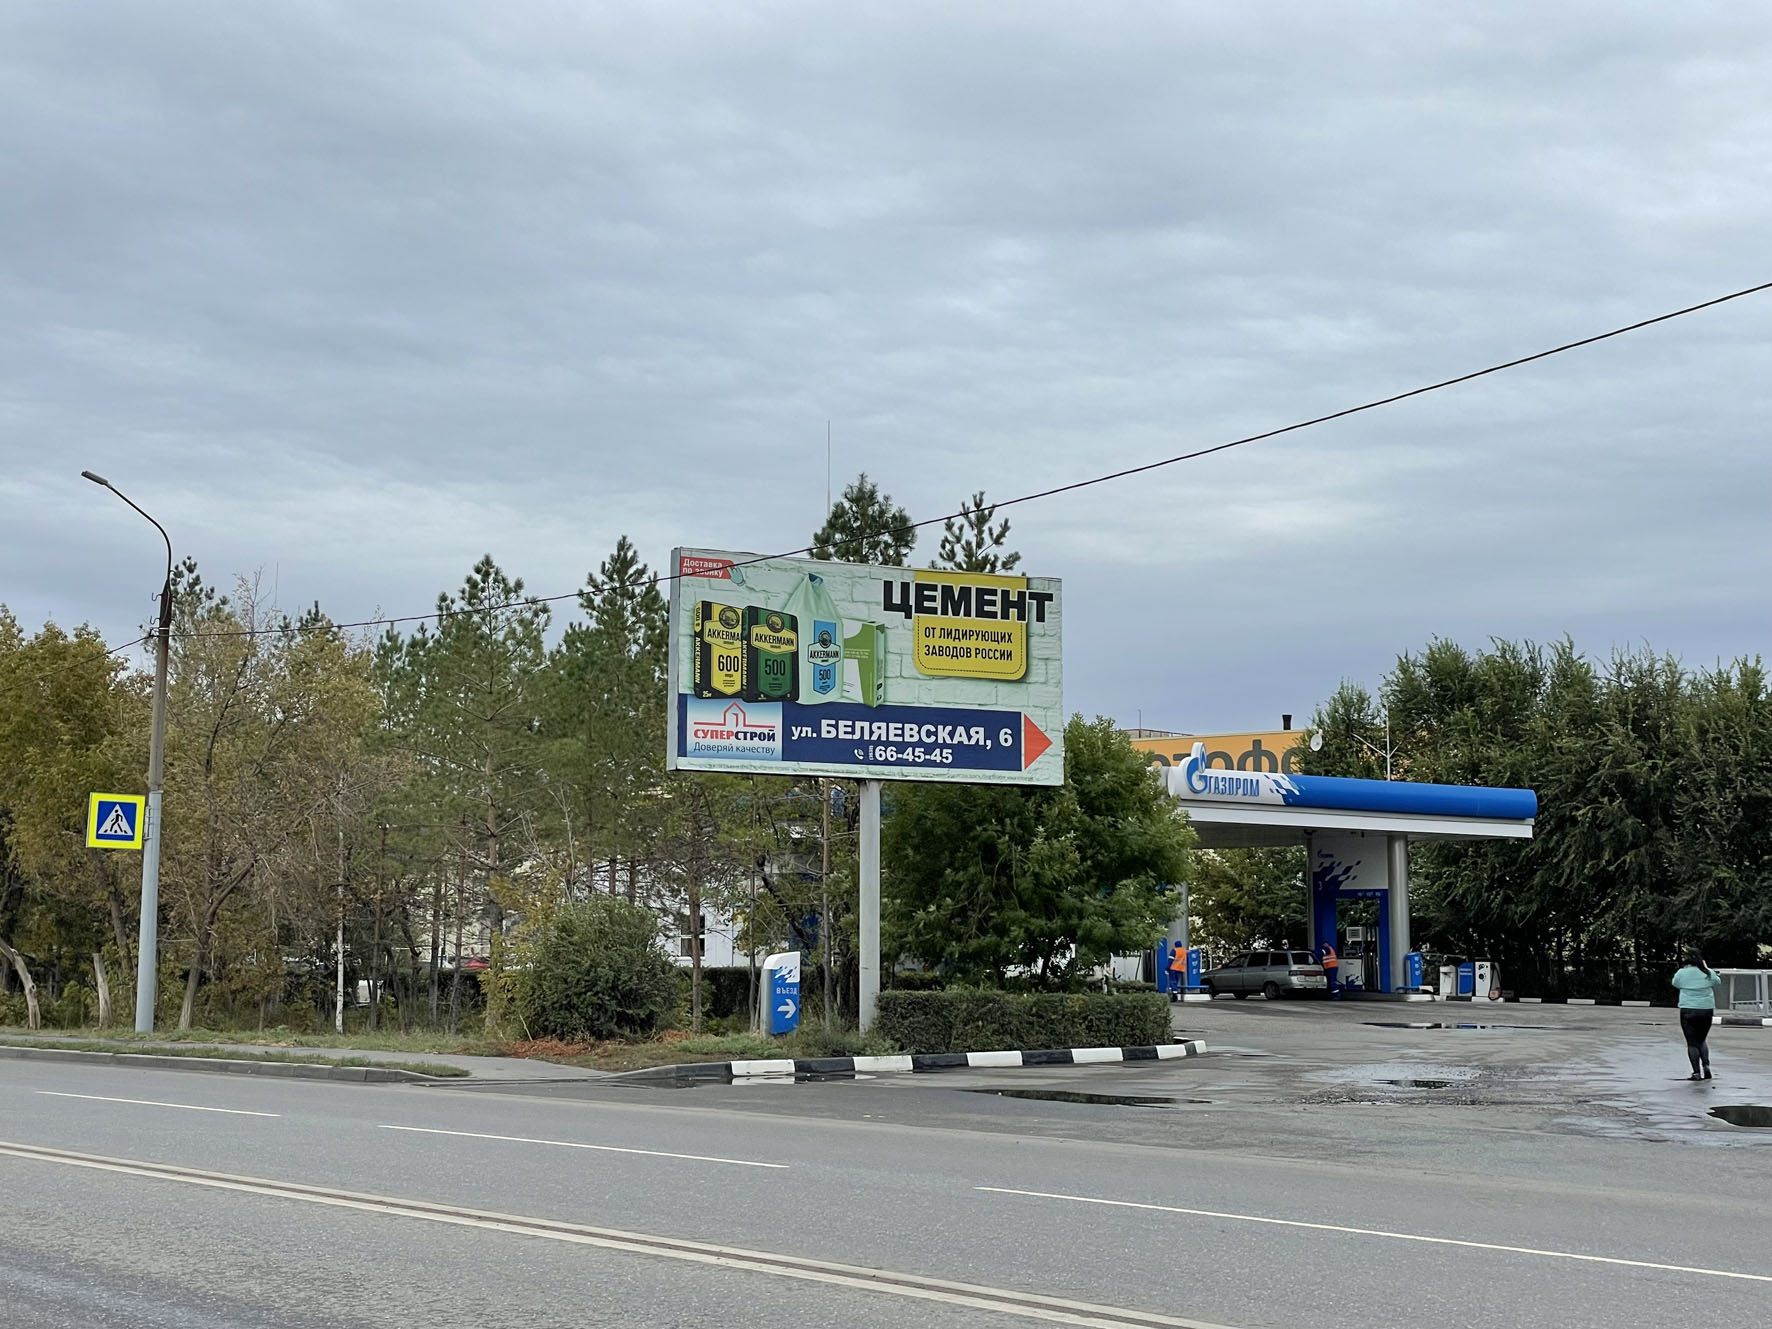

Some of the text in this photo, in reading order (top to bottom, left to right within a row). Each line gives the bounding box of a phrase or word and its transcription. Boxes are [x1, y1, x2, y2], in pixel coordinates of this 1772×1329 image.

[683, 558, 723, 567] Доставка
[883, 580, 1054, 623] ЦЕМЕНТ
[754, 632, 795, 648] AKKERMANN
[924, 627, 1013, 644] ОТ ЛИДИРУЮЩИХ
[810, 650, 839, 659] AKKERMANN
[924, 644, 1013, 662] ЗАВОДОВ РОССИИ
[718, 654, 740, 673] 600
[764, 658, 786, 676] 500
[818, 668, 832, 681] 500
[693, 728, 776, 742] СУПЕРСТРОЙ
[791, 719, 1013, 750] ул. БЕЛЯЕВСКАЯ, 6
[693, 741, 776, 756] Доверяй качеству
[874, 745, 953, 764] 66-45-45
[1207, 775, 1260, 797] ГАЗПРОМ
[776, 987, 798, 995] ВЪЕЗД
